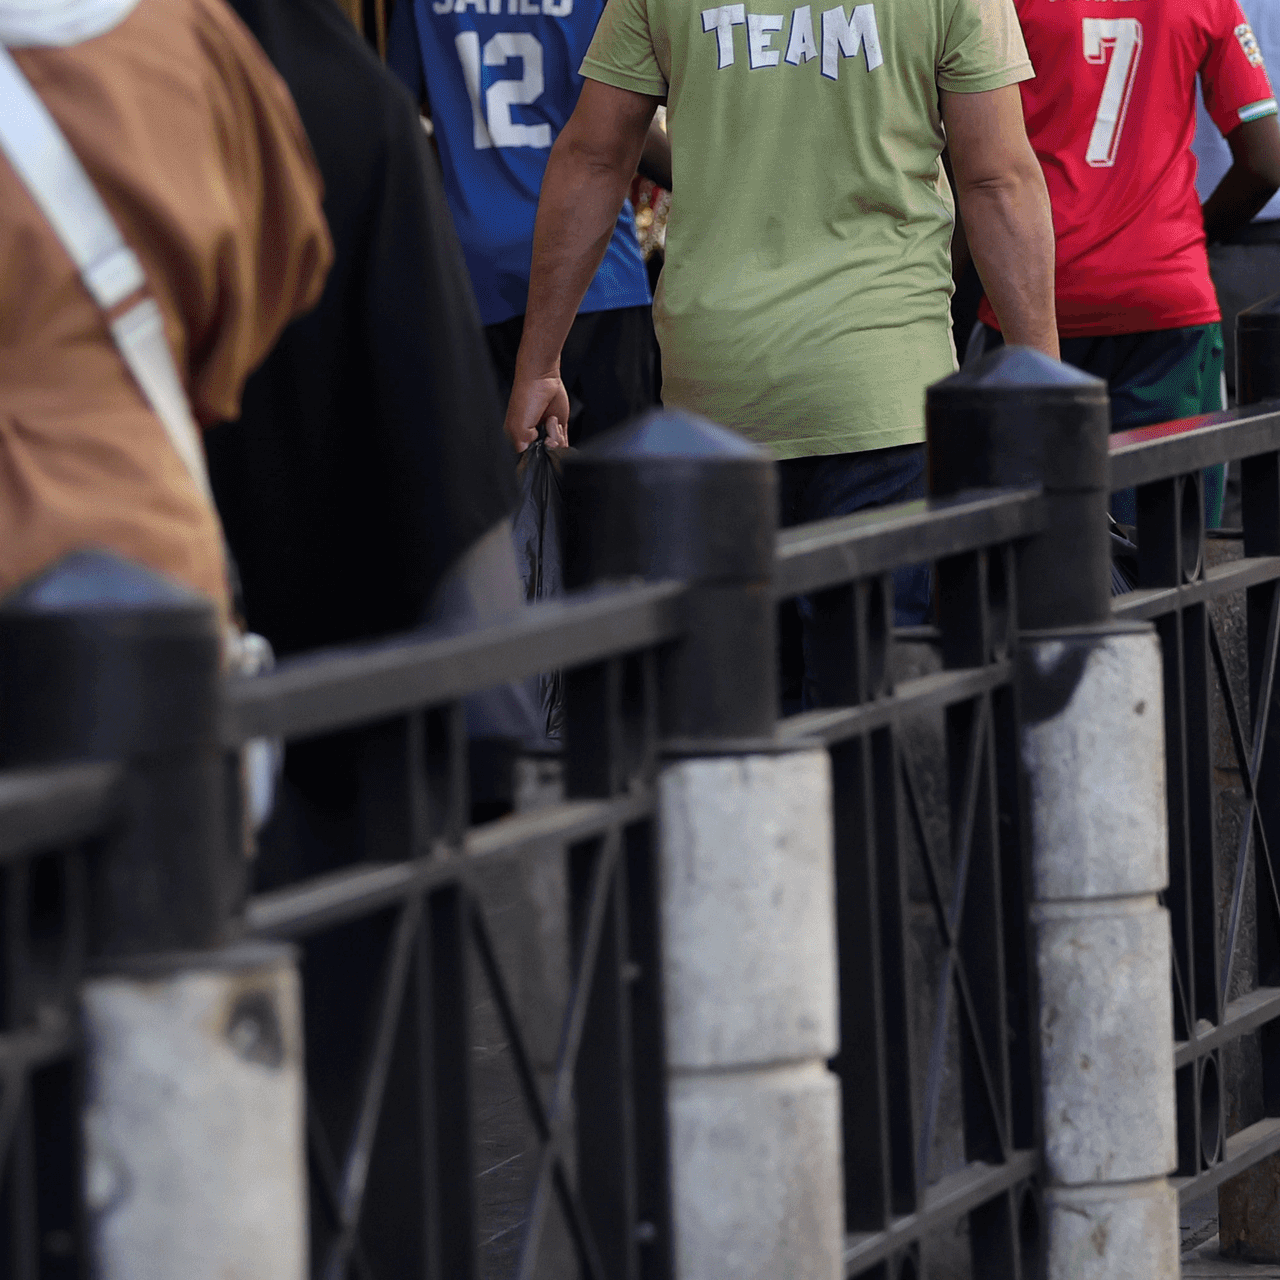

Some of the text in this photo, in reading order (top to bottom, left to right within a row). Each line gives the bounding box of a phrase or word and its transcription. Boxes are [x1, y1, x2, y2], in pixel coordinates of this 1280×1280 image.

[455, 31, 552, 149] 12
[701, 3, 884, 81] TEAM
[1082, 17, 1143, 167] 7
